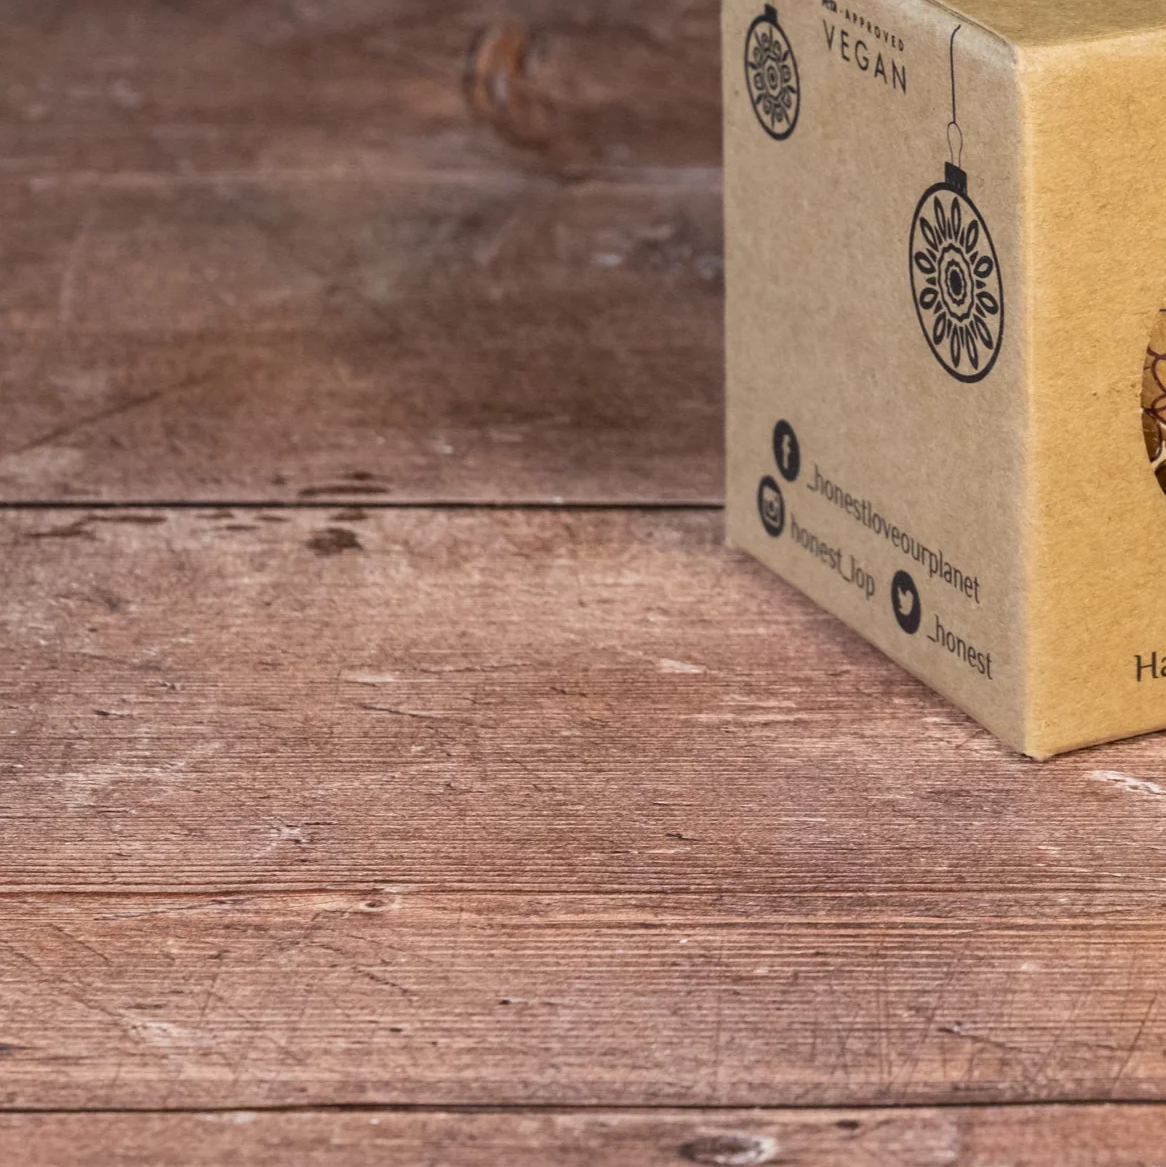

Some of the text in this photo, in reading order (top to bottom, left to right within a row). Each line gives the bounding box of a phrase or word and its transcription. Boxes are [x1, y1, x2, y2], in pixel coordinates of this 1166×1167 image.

[822, 19, 907, 94] VEGAN
[790, 512, 876, 601] honest_lop
[806, 463, 981, 605] _honestloveourplanet
[926, 614, 994, 681] _honest
